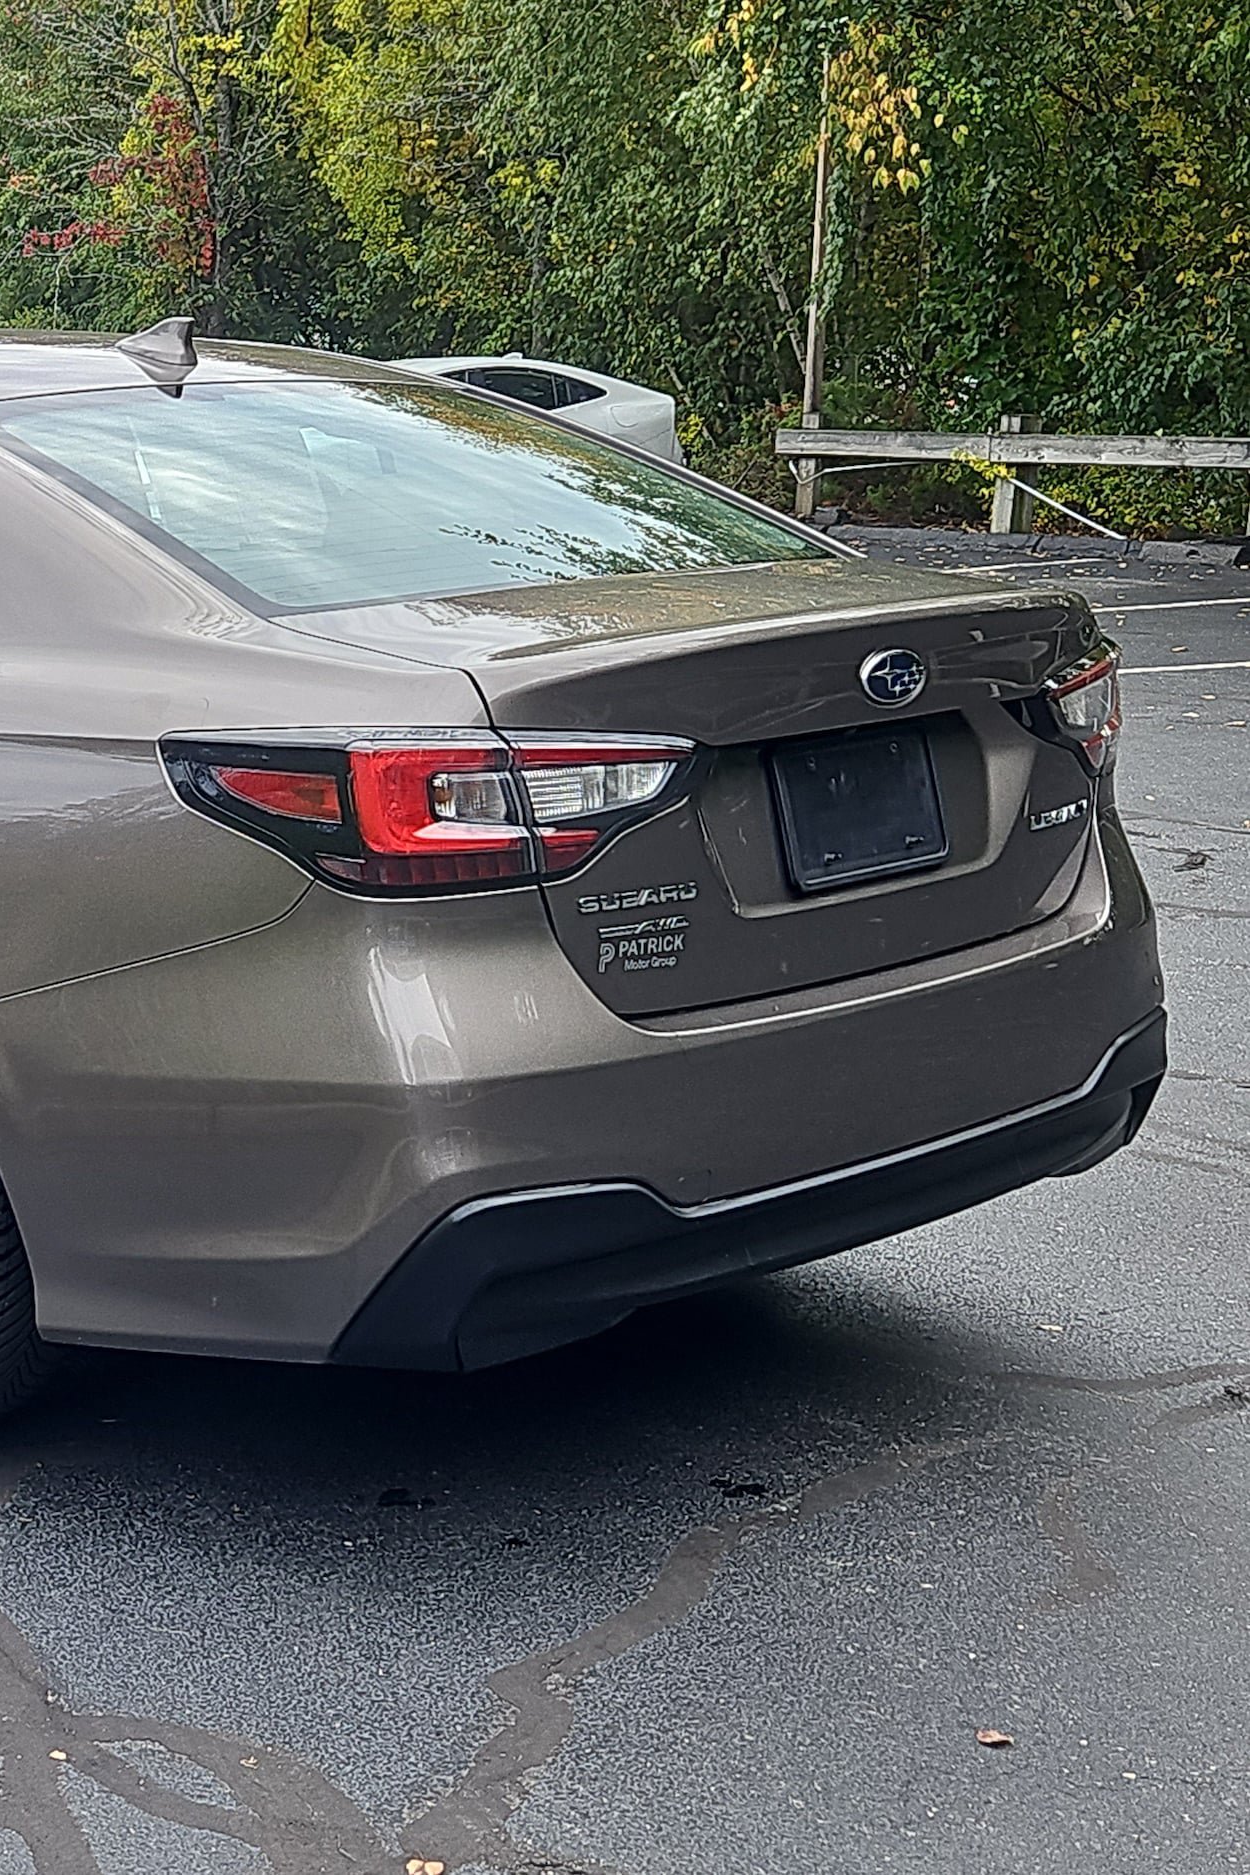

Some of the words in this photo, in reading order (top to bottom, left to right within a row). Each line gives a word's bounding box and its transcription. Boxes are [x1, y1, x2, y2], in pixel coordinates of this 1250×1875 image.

[578, 882, 697, 913] SUBARU
[618, 933, 686, 958] PATRICK
[624, 957, 651, 972] Motor
[651, 956, 678, 968] Group
